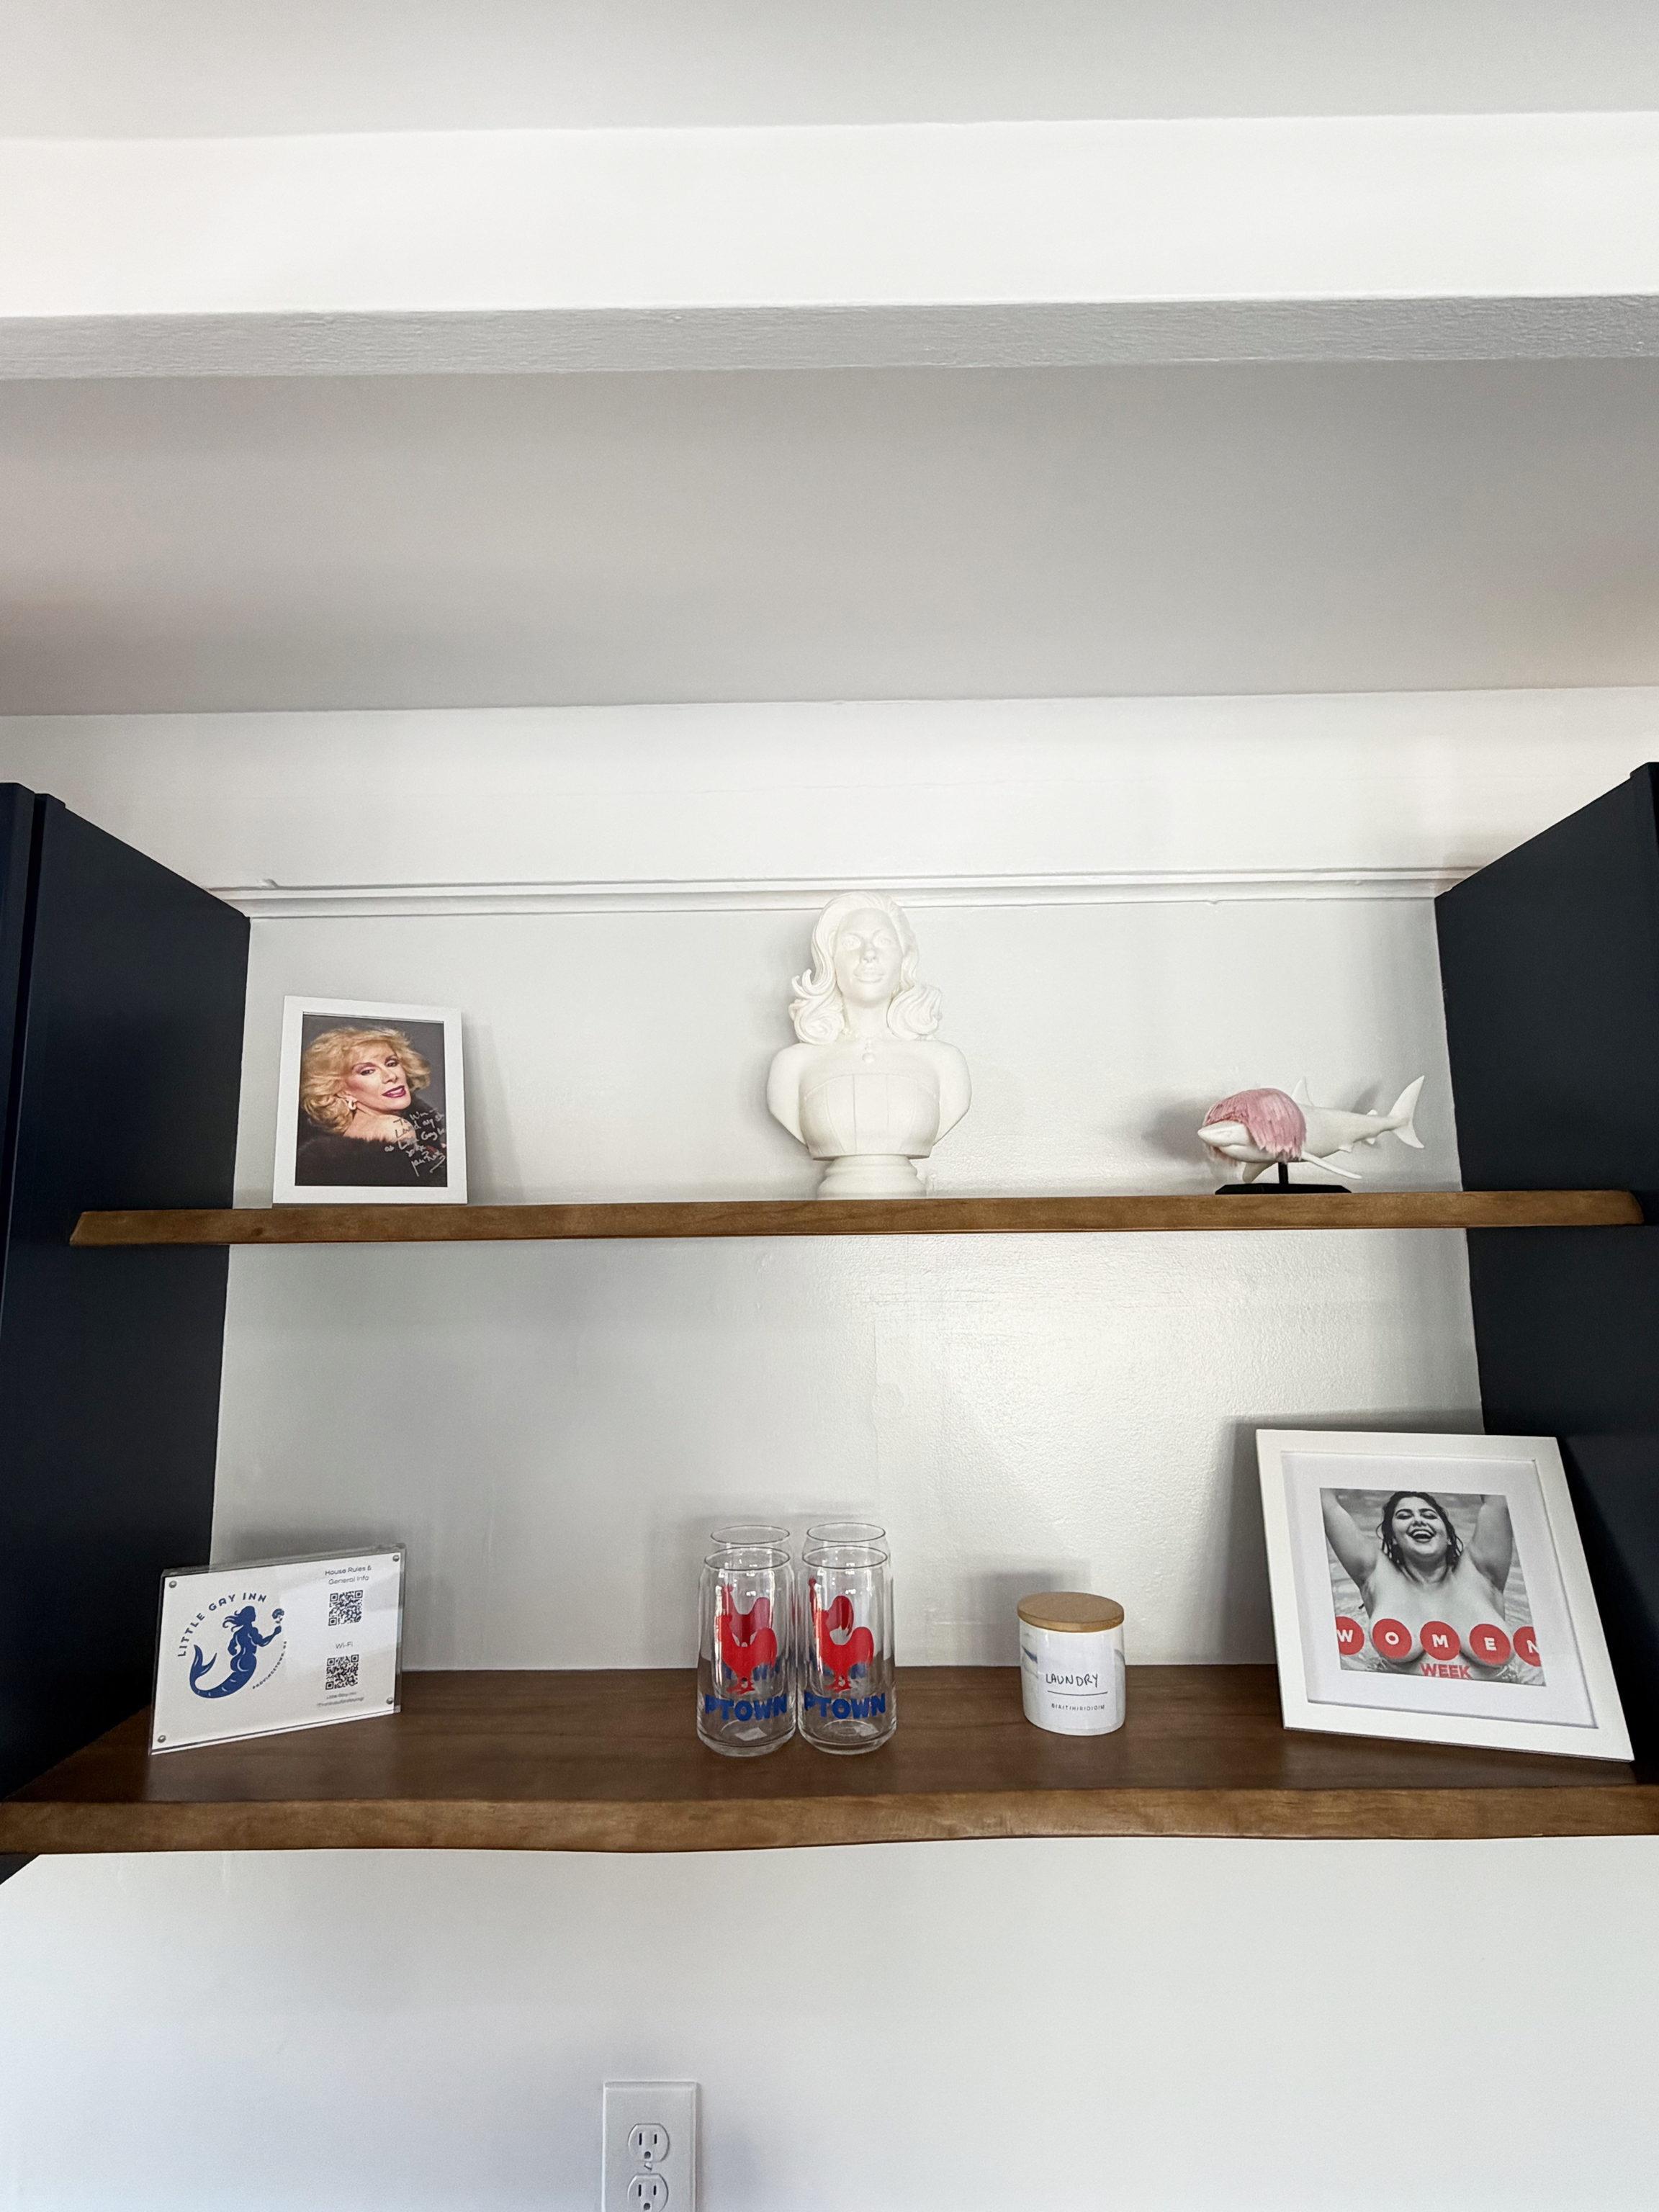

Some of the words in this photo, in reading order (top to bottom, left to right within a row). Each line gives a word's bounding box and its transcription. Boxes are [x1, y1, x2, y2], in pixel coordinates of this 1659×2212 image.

[328, 1576, 356, 1585] General
[177, 1612, 205, 1657] LITTLE
[208, 1593, 235, 1611] GAY
[243, 1592, 266, 1602] INN
[1046, 1673, 1098, 1688] LAUNDRY
[1419, 1663, 1473, 1680] WEEK
[705, 1693, 787, 1722] PTOWN
[804, 1689, 886, 1719] PTOWN
